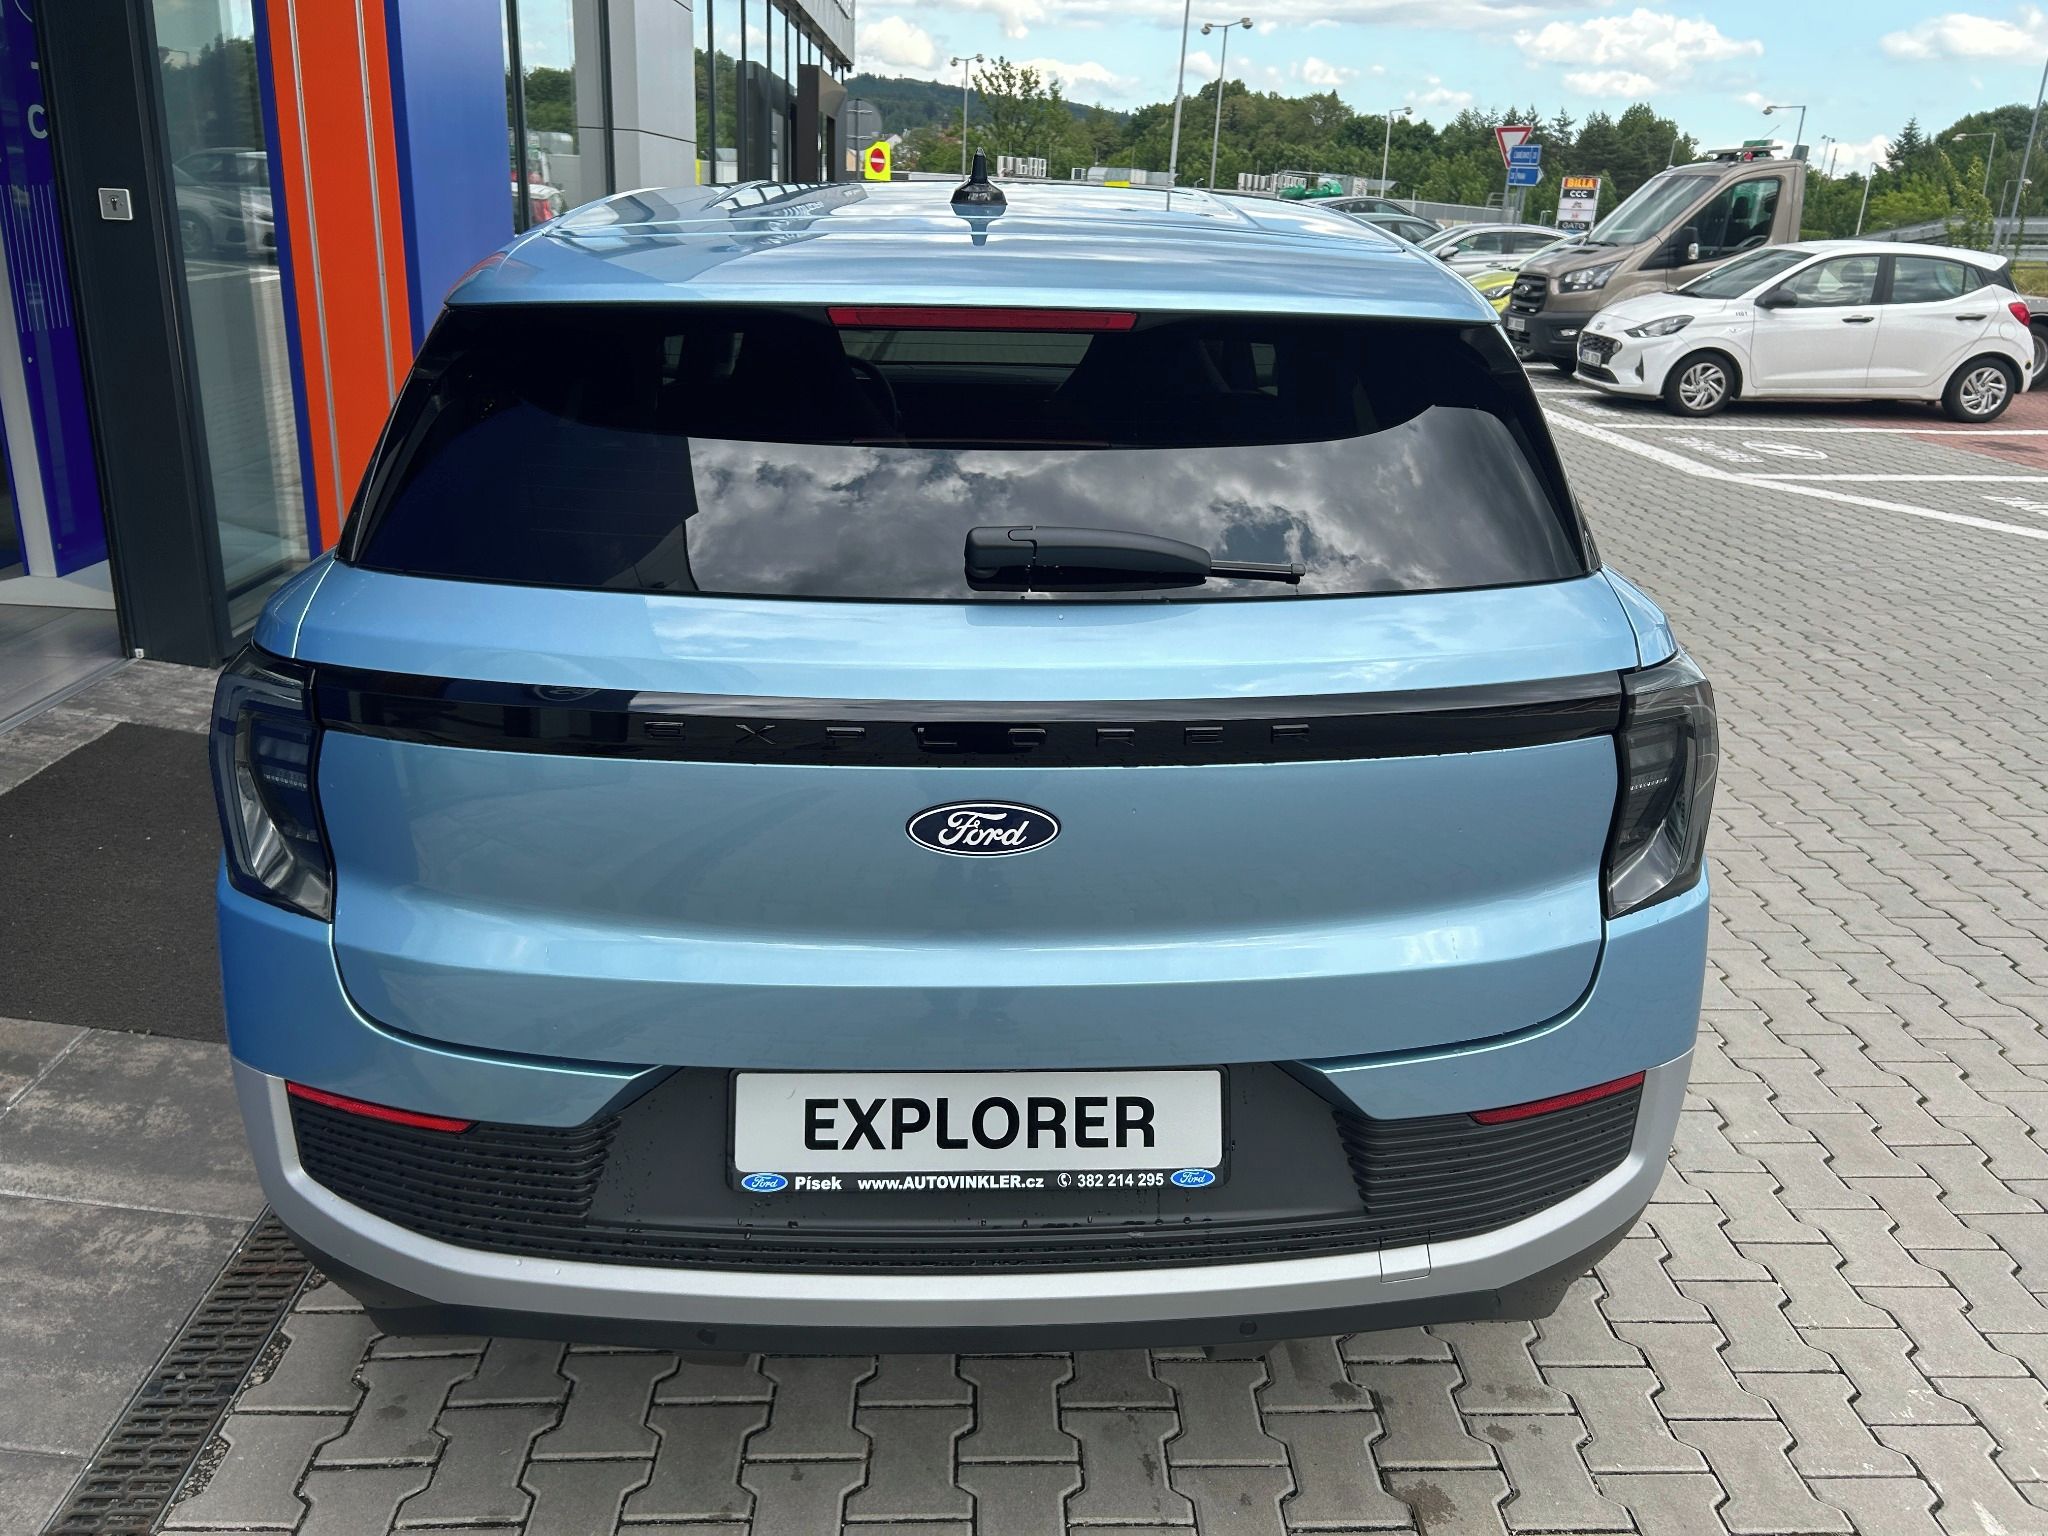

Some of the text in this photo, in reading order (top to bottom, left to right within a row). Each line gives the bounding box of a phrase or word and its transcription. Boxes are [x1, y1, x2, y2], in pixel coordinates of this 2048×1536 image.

[1566, 178, 1594, 188] BILLA
[1569, 190, 1588, 198] CCC
[937, 810, 1030, 846] Ford
[804, 1096, 1155, 1150] EXPLORER
[751, 1176, 778, 1188] Ford
[794, 1172, 1165, 1191] Písek www.AUTOVINKLER.cz 382 214 295
[1180, 1171, 1207, 1184] Ford
